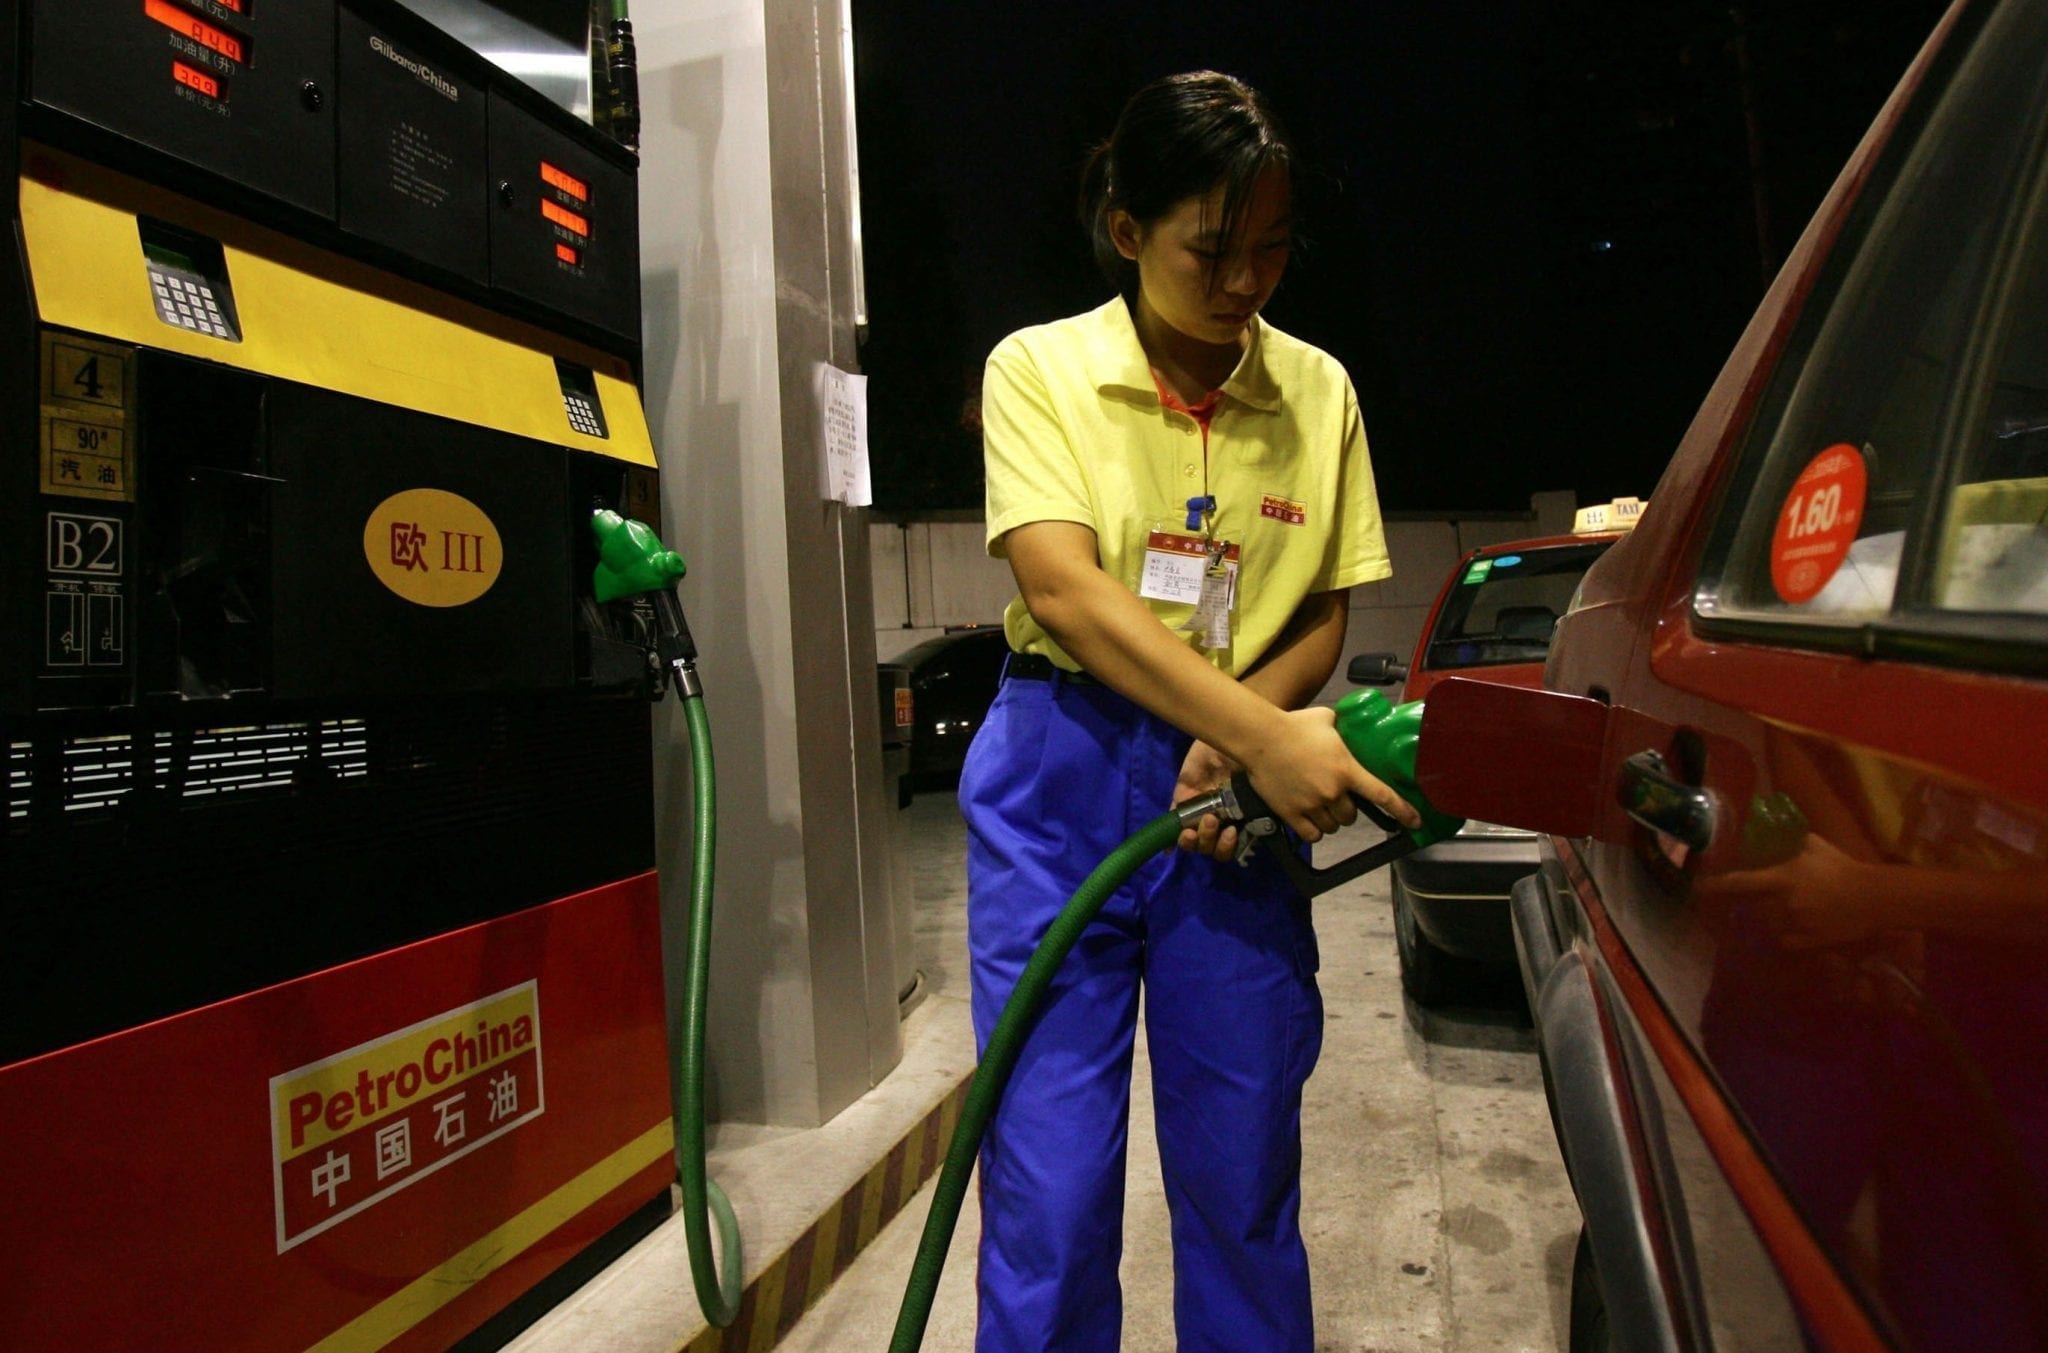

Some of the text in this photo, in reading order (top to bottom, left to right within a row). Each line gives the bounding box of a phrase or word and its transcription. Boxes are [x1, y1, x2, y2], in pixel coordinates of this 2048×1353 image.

[73, 356, 103, 399] 4
[61, 459, 116, 485] 汽油
[1616, 503, 1639, 515] TAXI
[1788, 483, 1842, 540] 1.60
[55, 519, 117, 571] B2
[390, 522, 485, 574] 欧 III
[289, 1014, 533, 1150] PetroChina
[311, 1069, 519, 1208] 中国石油
